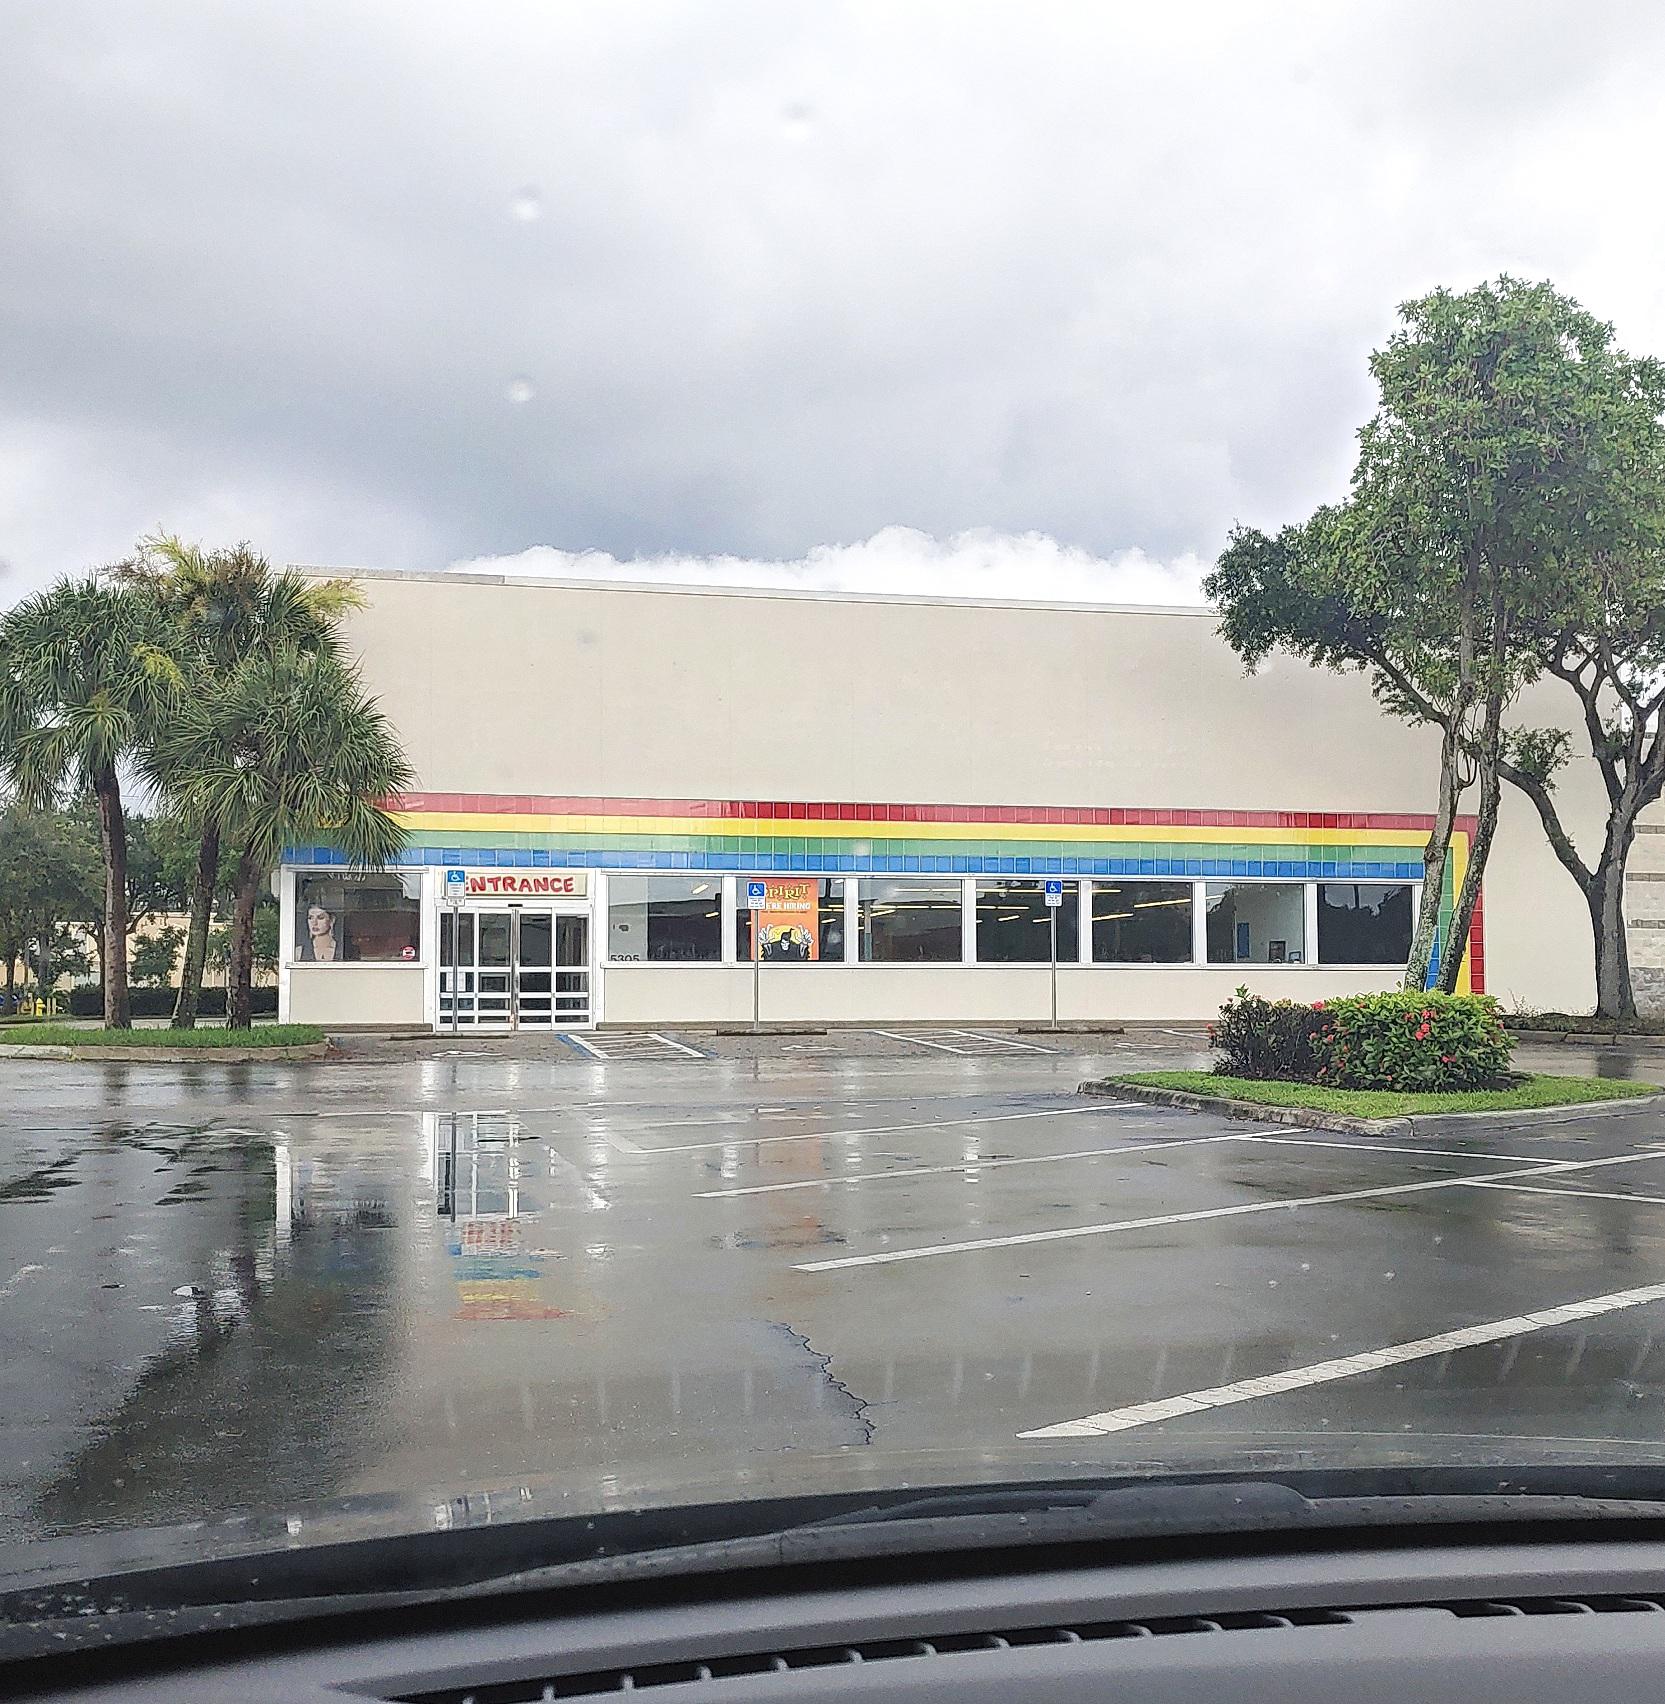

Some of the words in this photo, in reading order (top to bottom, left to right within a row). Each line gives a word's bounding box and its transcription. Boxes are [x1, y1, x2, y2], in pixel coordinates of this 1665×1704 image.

[466, 876, 574, 892] NTRANCE
[766, 883, 810, 899] PIRIT
[784, 901, 811, 910] HIRING
